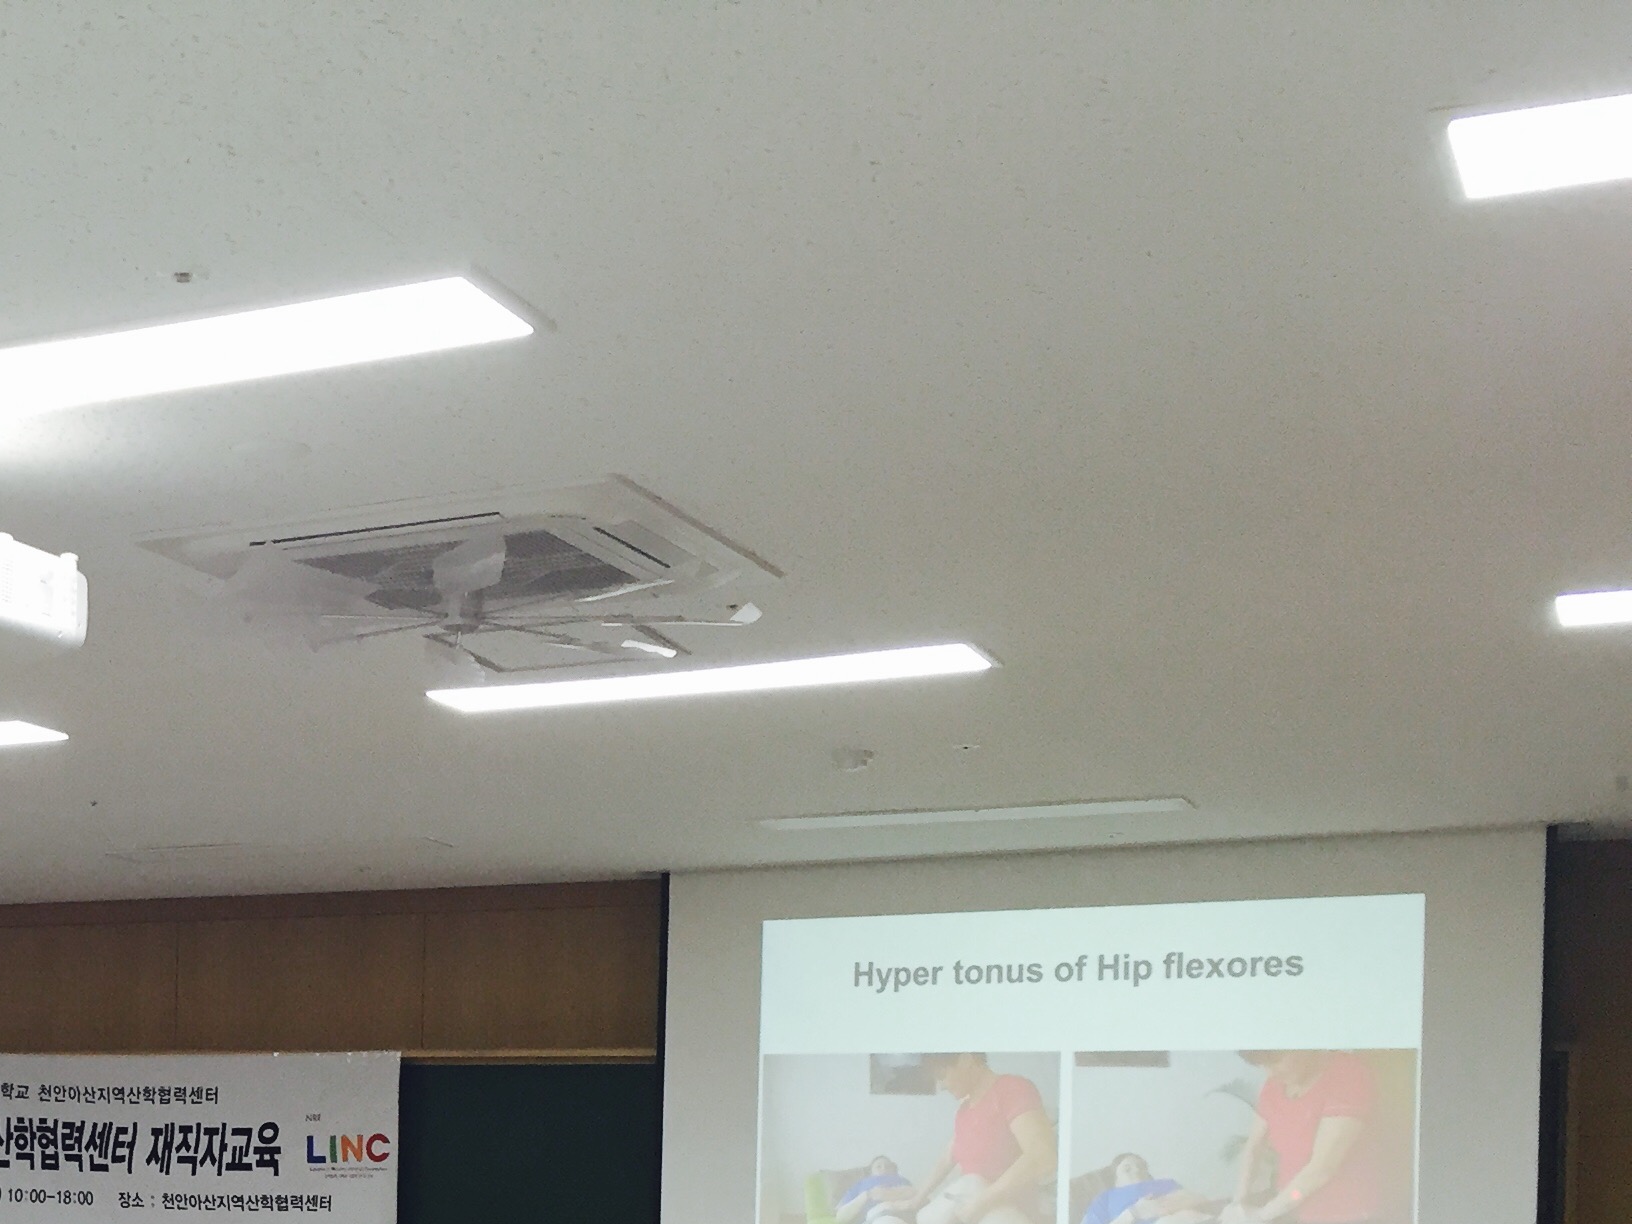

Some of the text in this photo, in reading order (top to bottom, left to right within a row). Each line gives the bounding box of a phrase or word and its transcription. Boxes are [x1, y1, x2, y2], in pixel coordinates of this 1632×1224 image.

[853, 951, 1305, 994] Hyper tonus of Hip flexores
[37, 1083, 219, 1105] 천안아산지역산학협력센터
[145, 1121, 282, 1177] 재직자교육
[306, 1133, 391, 1163] LINC
[118, 1191, 145, 1209] 장소
